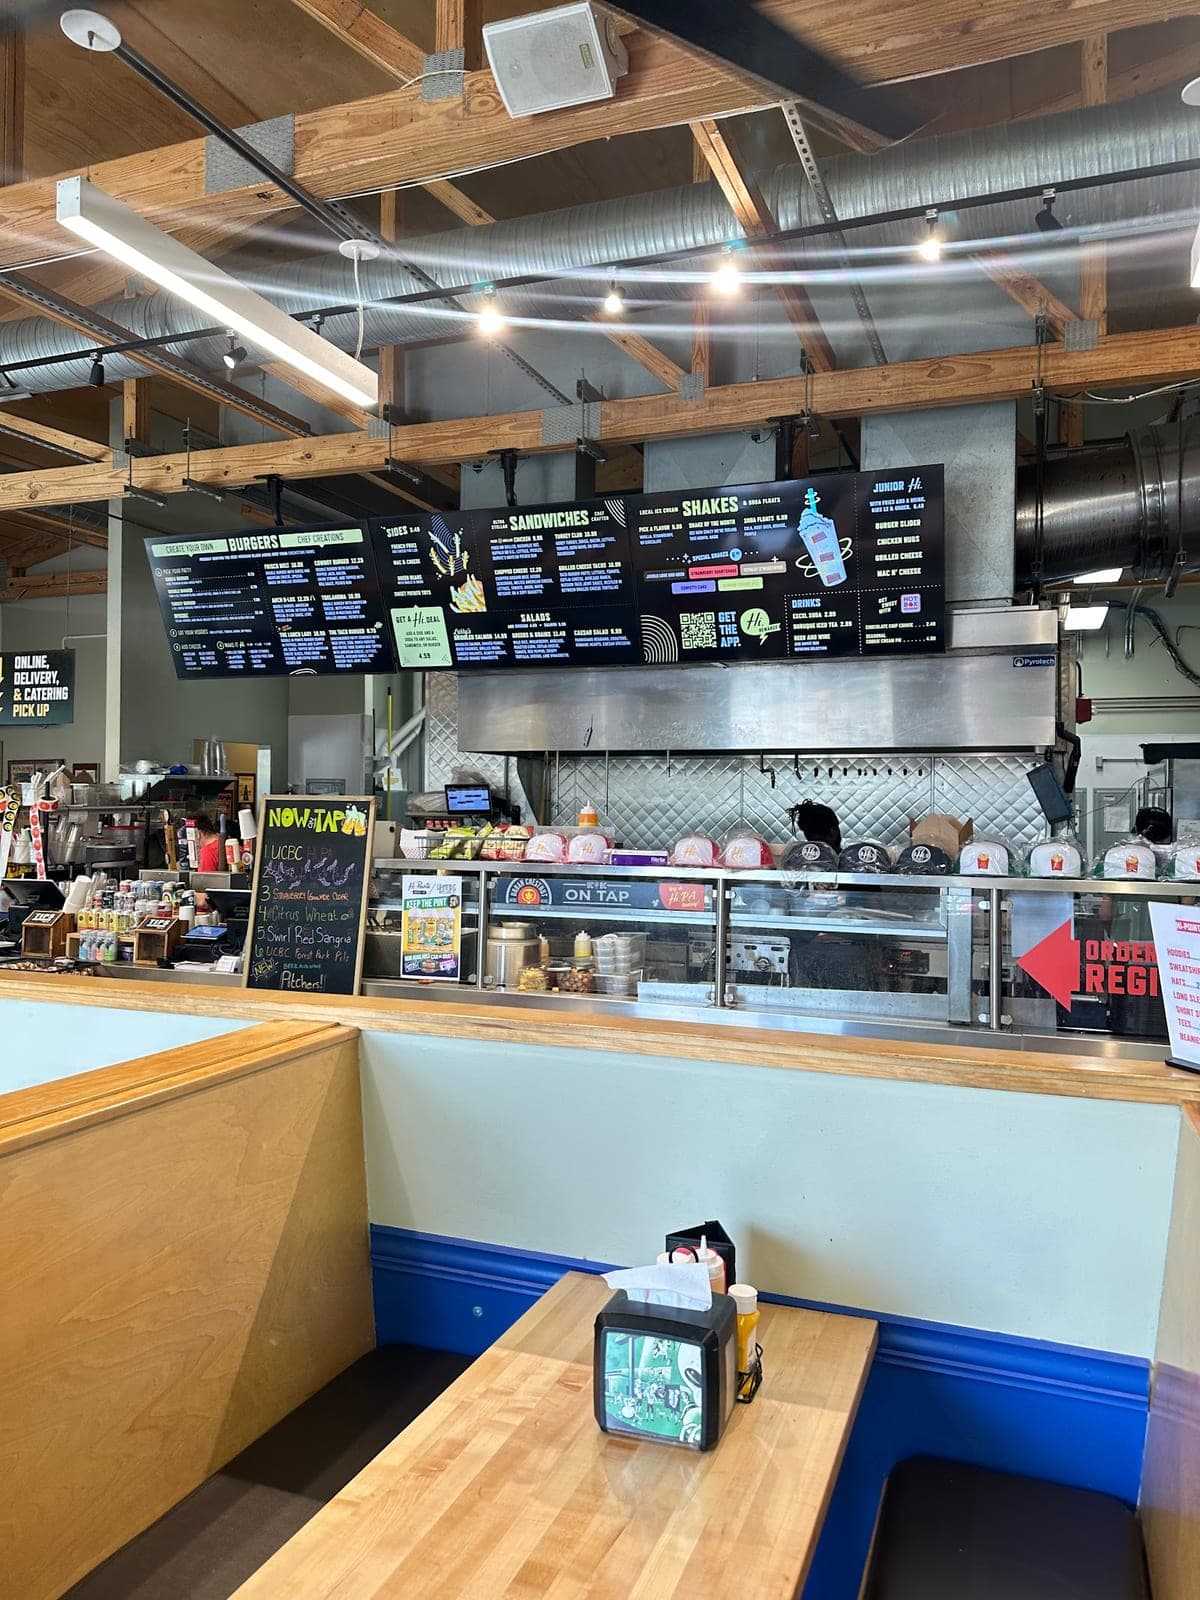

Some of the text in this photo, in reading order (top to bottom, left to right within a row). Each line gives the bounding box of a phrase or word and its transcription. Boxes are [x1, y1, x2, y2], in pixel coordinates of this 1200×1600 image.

[873, 481, 904, 493] JUNIOR
[682, 496, 738, 517] SHAKES
[509, 510, 590, 531] SANDWICHES
[875, 519, 921, 529] BURGER SLIDER
[386, 526, 408, 537] SIDES
[229, 535, 279, 552] BURGERS
[297, 533, 344, 543] CHEF CREATIONS
[877, 537, 902, 545] CHICKEN
[166, 543, 214, 553] CREATE YOUR OWN
[692, 554, 710, 562] SPECIAL
[875, 552, 923, 561] GRILLED CHEESE
[792, 598, 821, 608] DRINKS
[520, 613, 550, 622] SALADS
[718, 612, 736, 622] GET
[746, 612, 762, 630] Hi
[719, 624, 737, 635] THE
[720, 637, 741, 647] APP.
[14, 655, 49, 669] ONLINE,
[1024, 658, 1054, 666] Pyrotech
[14, 671, 59, 685] DELIVERY,
[13, 687, 68, 701] & CATERING
[13, 704, 49, 717] PICK UP
[268, 807, 346, 833] NOW TAP
[271, 845, 303, 860] UCBC
[261, 885, 271, 901] 3
[566, 889, 629, 902] ON TAP
[407, 899, 447, 908] KEEP THE PINT
[34, 913, 55, 921] TIPS
[271, 907, 299, 922] Citrus
[306, 908, 337, 922] Wheat
[149, 919, 169, 927] TIPS
[267, 926, 351, 947] Swirl Red Sangria
[266, 947, 290, 958] UCBC
[1086, 940, 1158, 963] ORDER
[1167, 948, 1190, 958] HOODIES
[254, 962, 273, 976] NEW
[1085, 964, 1158, 996] REGI
[1171, 977, 1186, 987] HATS
[1173, 991, 1200, 1003] LONG SLE
[1176, 1005, 1193, 1016] SHORT
[1178, 1018, 1192, 1028] TEES
